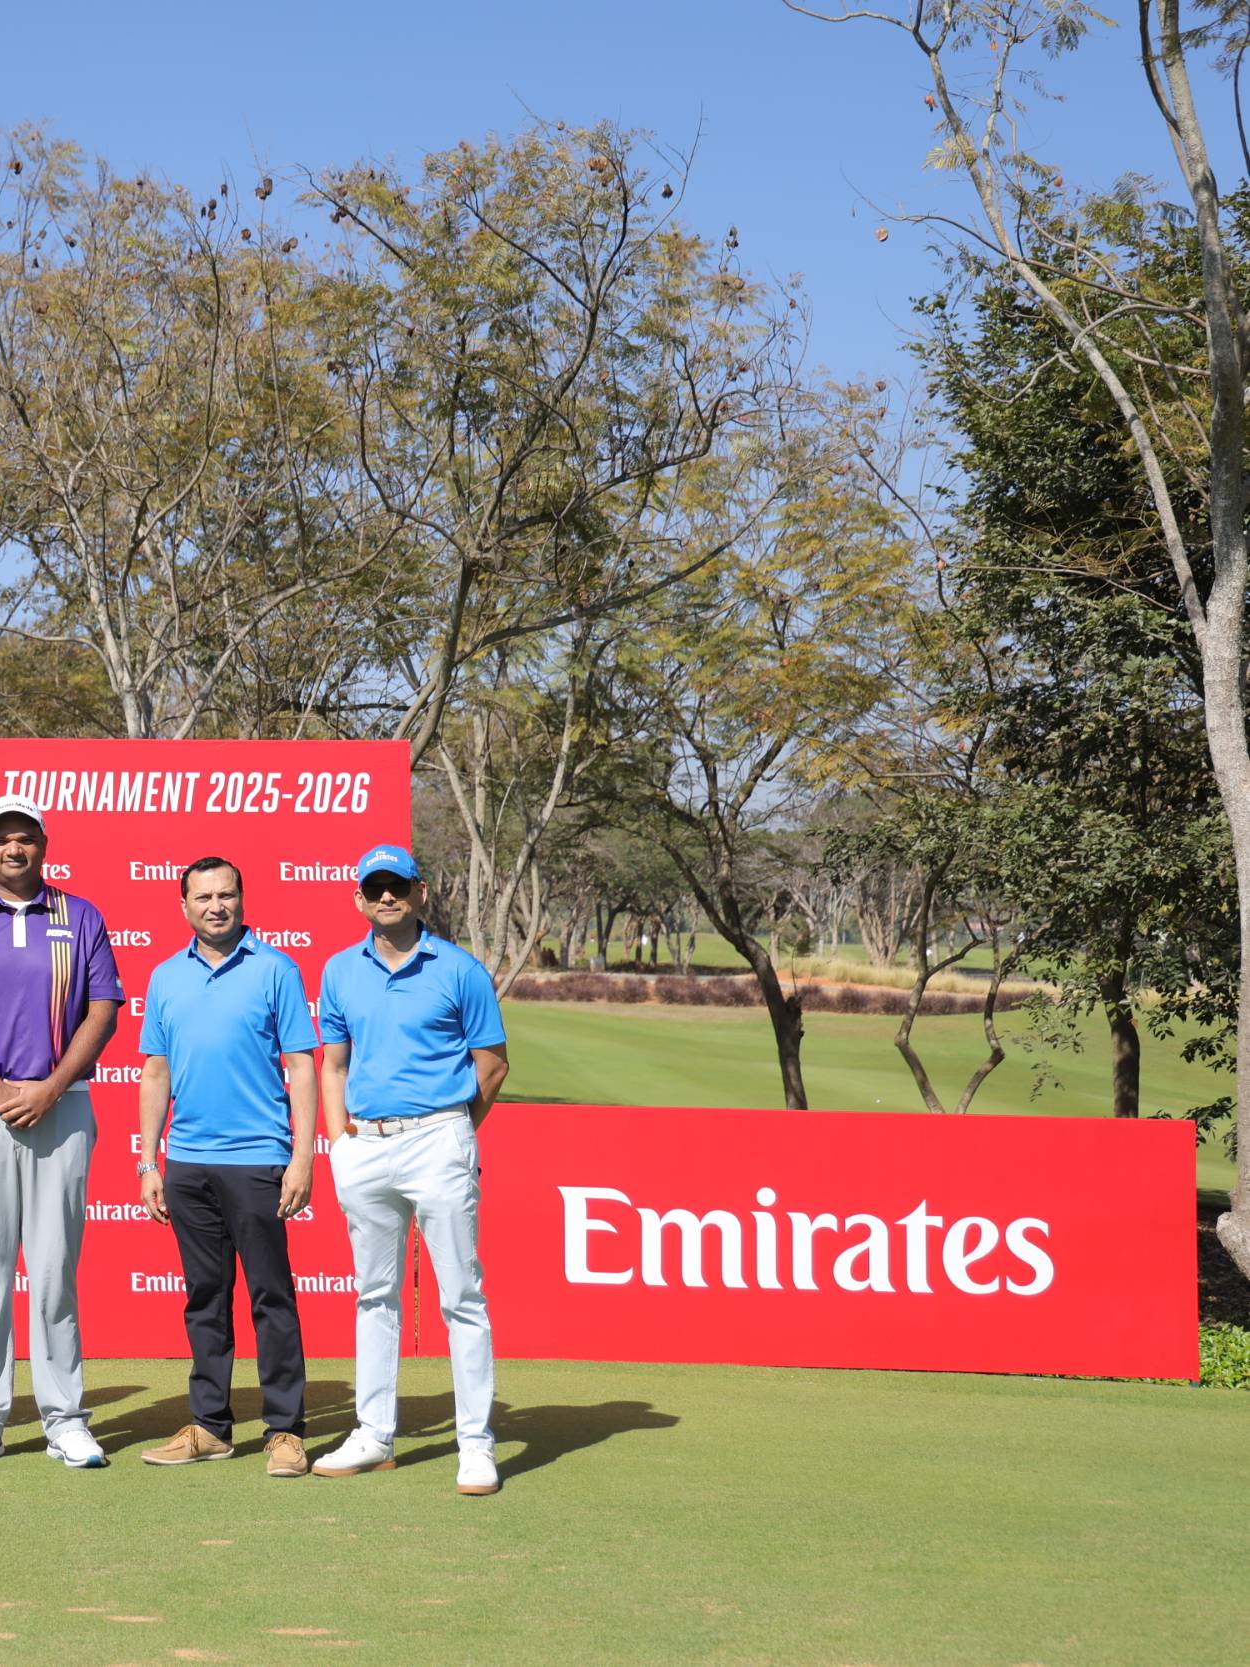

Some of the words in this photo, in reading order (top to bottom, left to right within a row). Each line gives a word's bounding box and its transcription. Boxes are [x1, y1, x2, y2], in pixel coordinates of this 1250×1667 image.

[4, 769, 201, 813] TOURNAMENT
[205, 771, 371, 814] 2025-2026
[129, 860, 188, 881] Emir
[279, 861, 359, 882] Emirate
[107, 927, 152, 946] ates
[255, 928, 312, 946] irates
[90, 1062, 142, 1083] irate
[85, 1200, 151, 1221] irates
[557, 1185, 1055, 1297] Emirates
[130, 1271, 186, 1292] Emir
